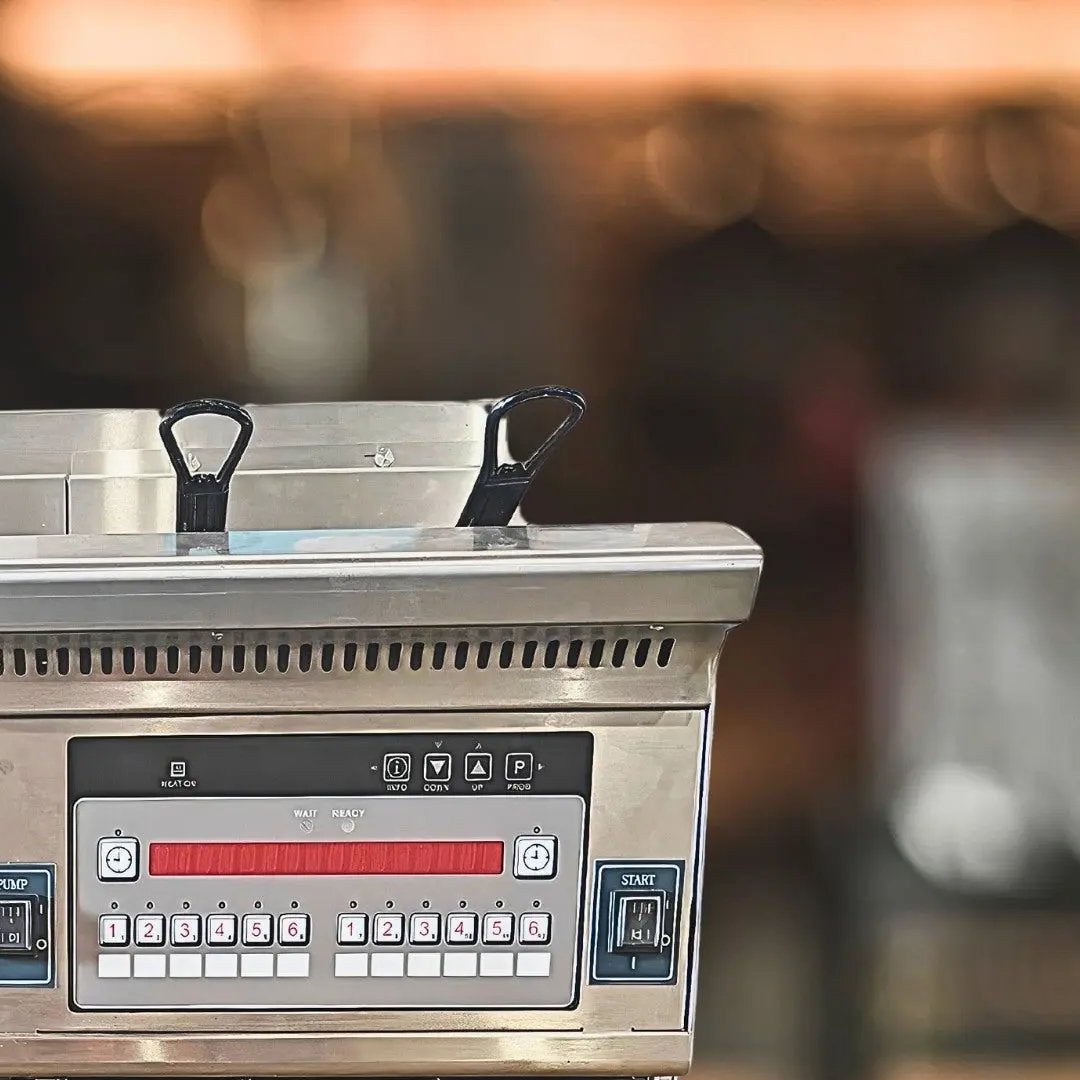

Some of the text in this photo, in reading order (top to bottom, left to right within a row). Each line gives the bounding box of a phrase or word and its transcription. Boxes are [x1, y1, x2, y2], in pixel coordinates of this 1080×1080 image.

[621, 874, 656, 886] START
[109, 923, 116, 938] 1
[144, 923, 154, 938] 2
[180, 923, 190, 937] 3
[215, 922, 225, 937] 4
[251, 922, 262, 937] 5
[287, 922, 298, 937] 6
[347, 921, 539, 937] 1 2 3 4 5 6
